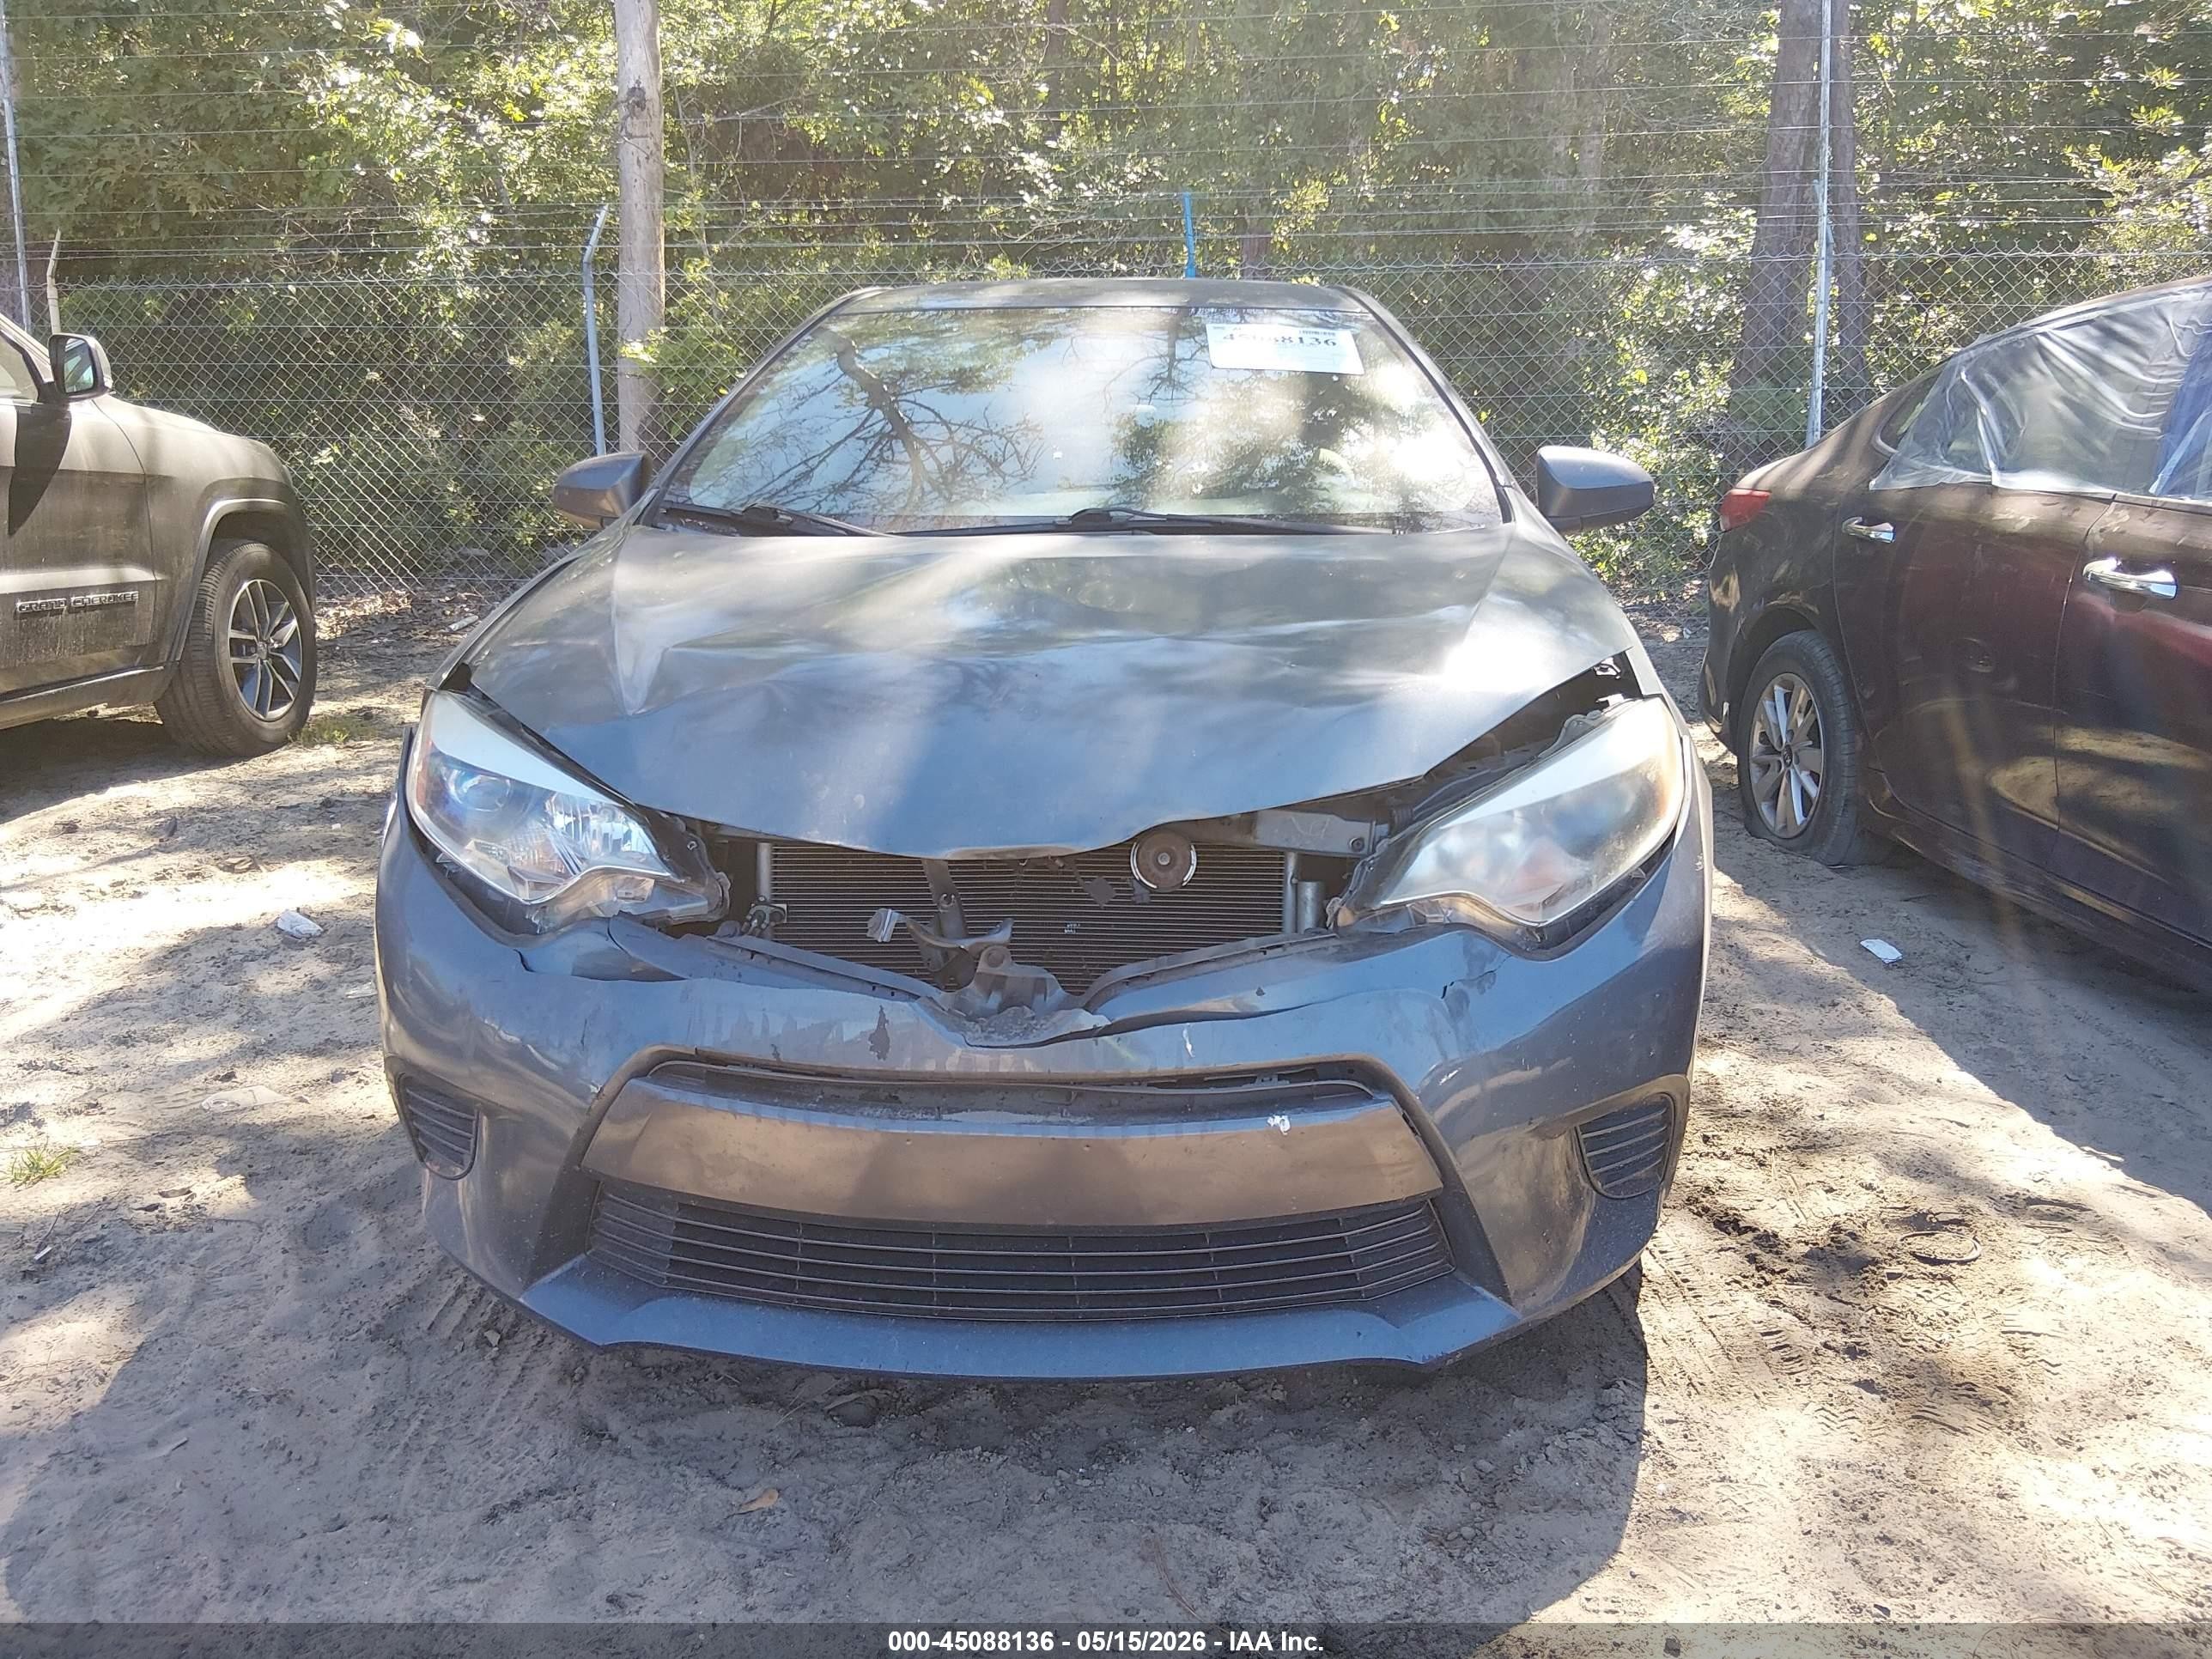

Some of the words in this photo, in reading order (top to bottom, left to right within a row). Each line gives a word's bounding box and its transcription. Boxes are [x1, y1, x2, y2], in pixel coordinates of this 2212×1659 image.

[1223, 333, 1338, 348] 488136
[16, 598, 67, 613] GRAND
[70, 591, 139, 607] CHEROKEE
